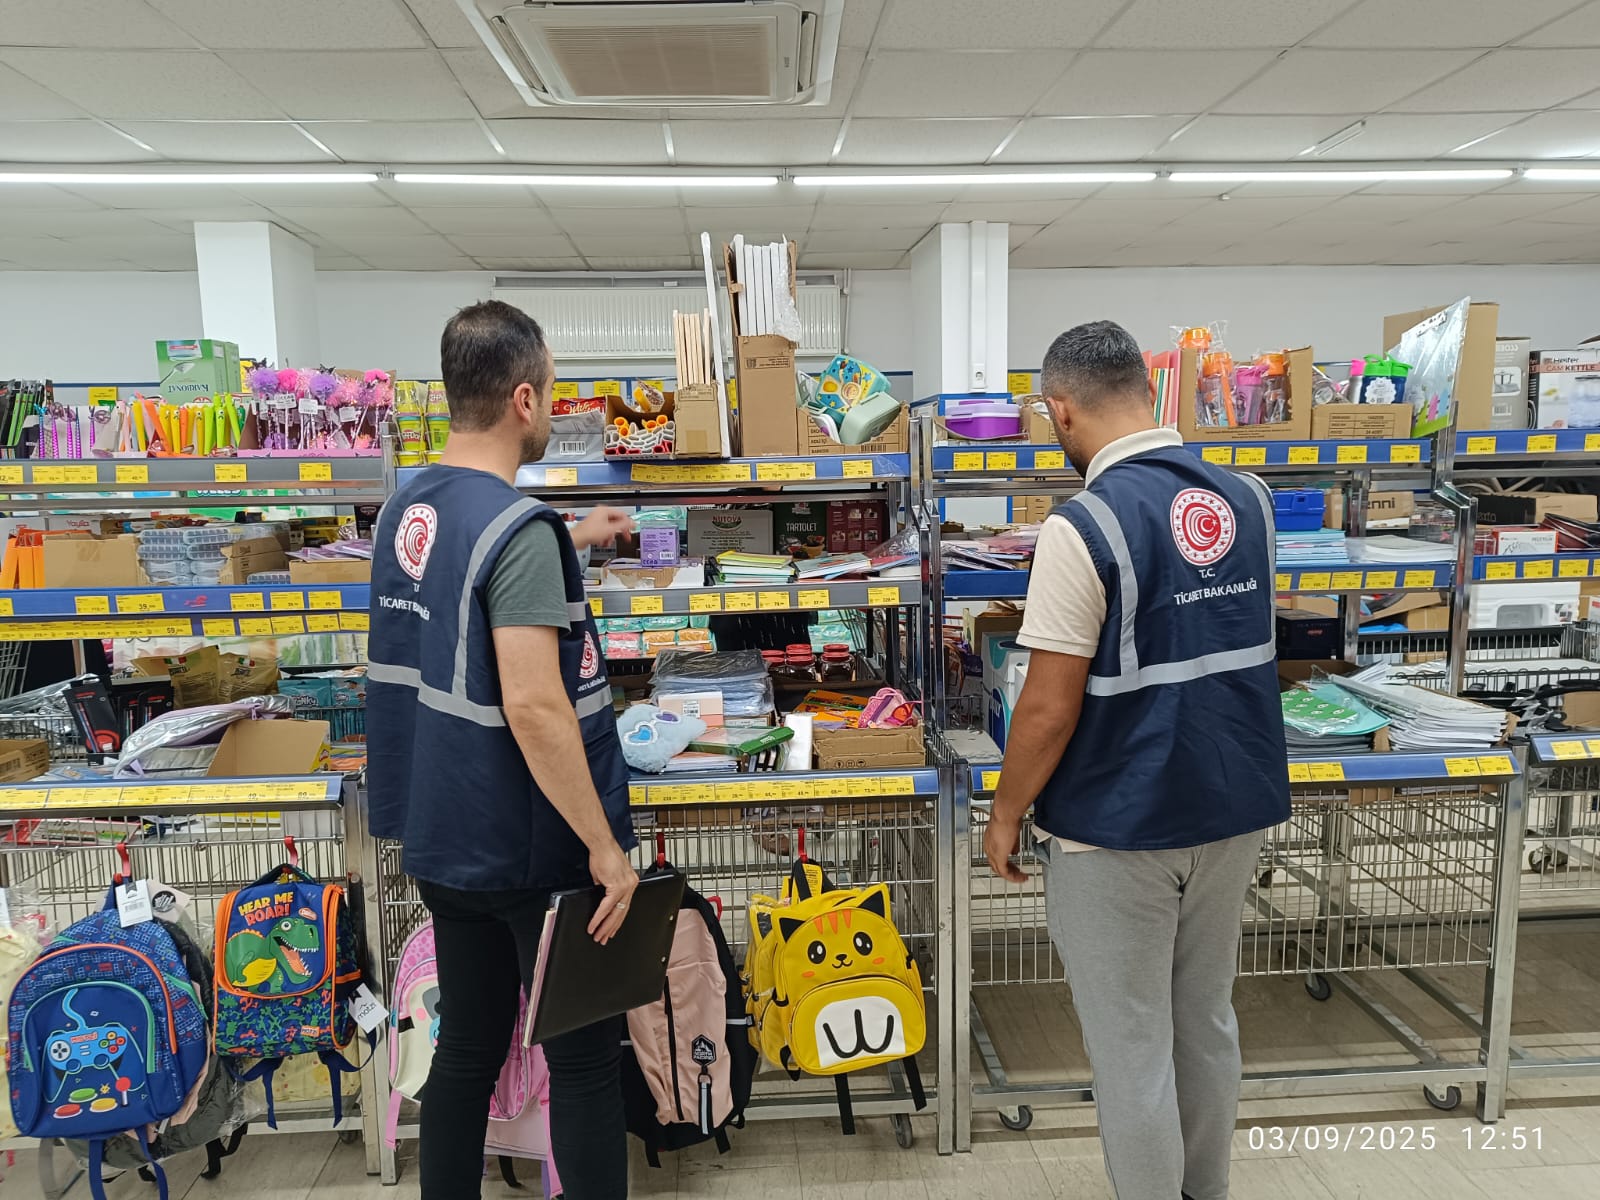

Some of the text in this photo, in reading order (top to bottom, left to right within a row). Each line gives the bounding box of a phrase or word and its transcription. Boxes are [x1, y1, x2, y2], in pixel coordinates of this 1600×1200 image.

[1565, 364, 1596, 372] KETTLE
[168, 383, 209, 394] KARBONAT
[786, 522, 817, 532] TARTOLET
[1198, 568, 1216, 579] T.C.
[379, 595, 412, 611] TİCARET
[1173, 589, 1203, 605] TİCARET
[238, 892, 294, 916] HEAR ME
[245, 903, 290, 926] ROAR!
